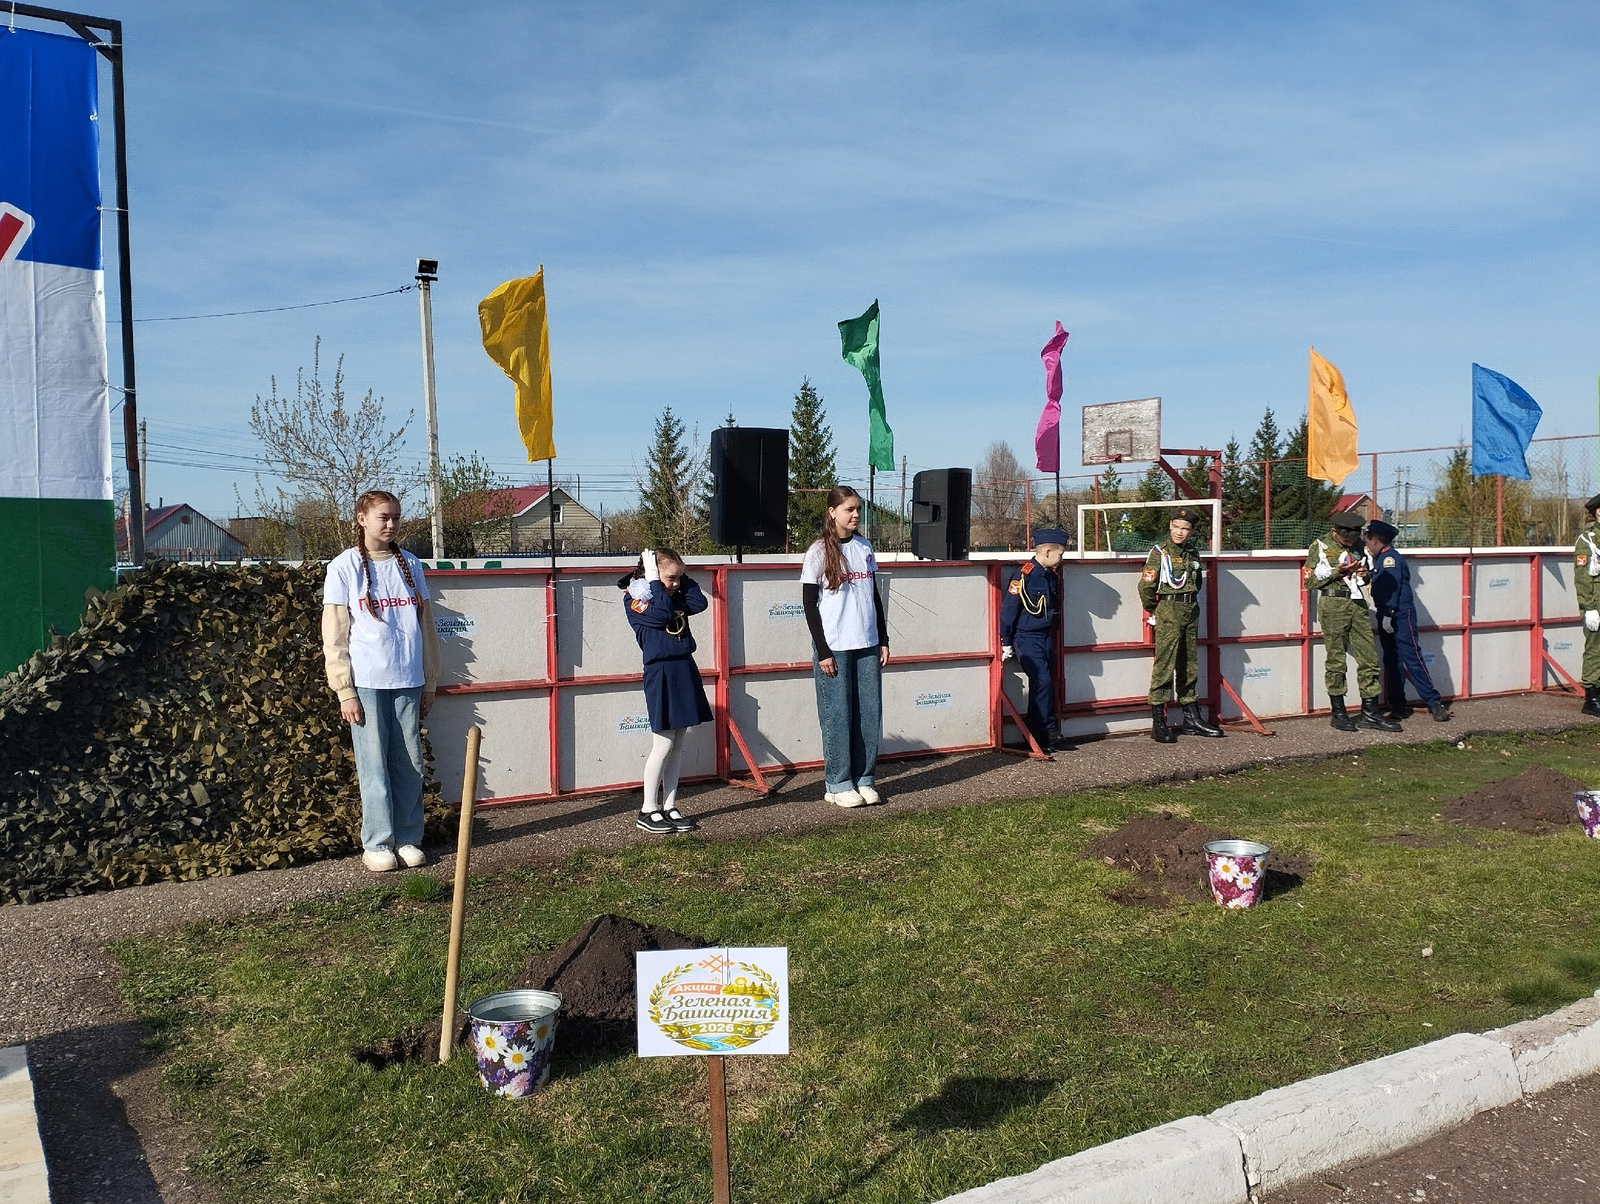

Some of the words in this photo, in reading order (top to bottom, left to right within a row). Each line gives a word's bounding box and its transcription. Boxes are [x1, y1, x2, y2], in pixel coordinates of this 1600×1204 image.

[674, 984, 717, 993] Акция
[662, 1005, 769, 1022] Башкирия
[699, 1023, 735, 1034] 2026
